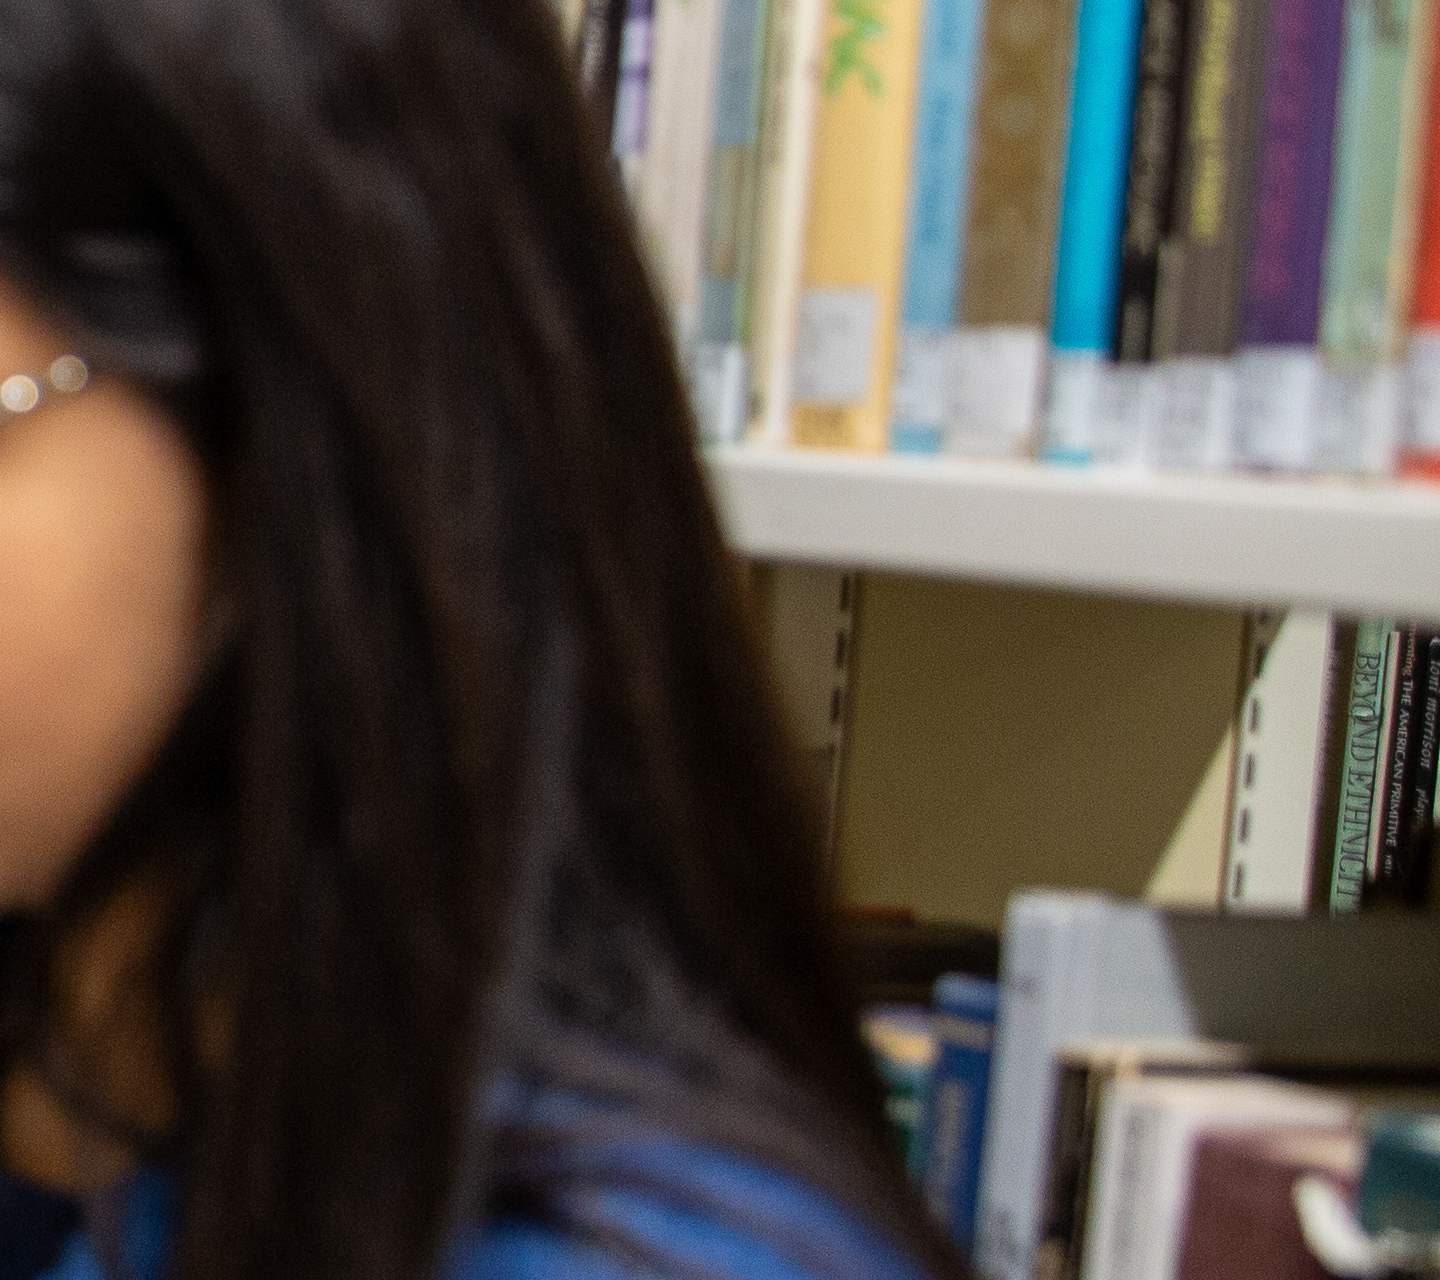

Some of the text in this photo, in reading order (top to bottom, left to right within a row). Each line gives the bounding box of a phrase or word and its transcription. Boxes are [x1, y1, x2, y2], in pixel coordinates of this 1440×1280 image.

[1400, 679, 1414, 705] THE
[1392, 708, 1411, 779] AMERICAN
[1419, 696, 1438, 770] morrison
[1334, 650, 1383, 900] BEYOND ETHNICIT
[1385, 781, 1403, 847] PRIMITIVE
